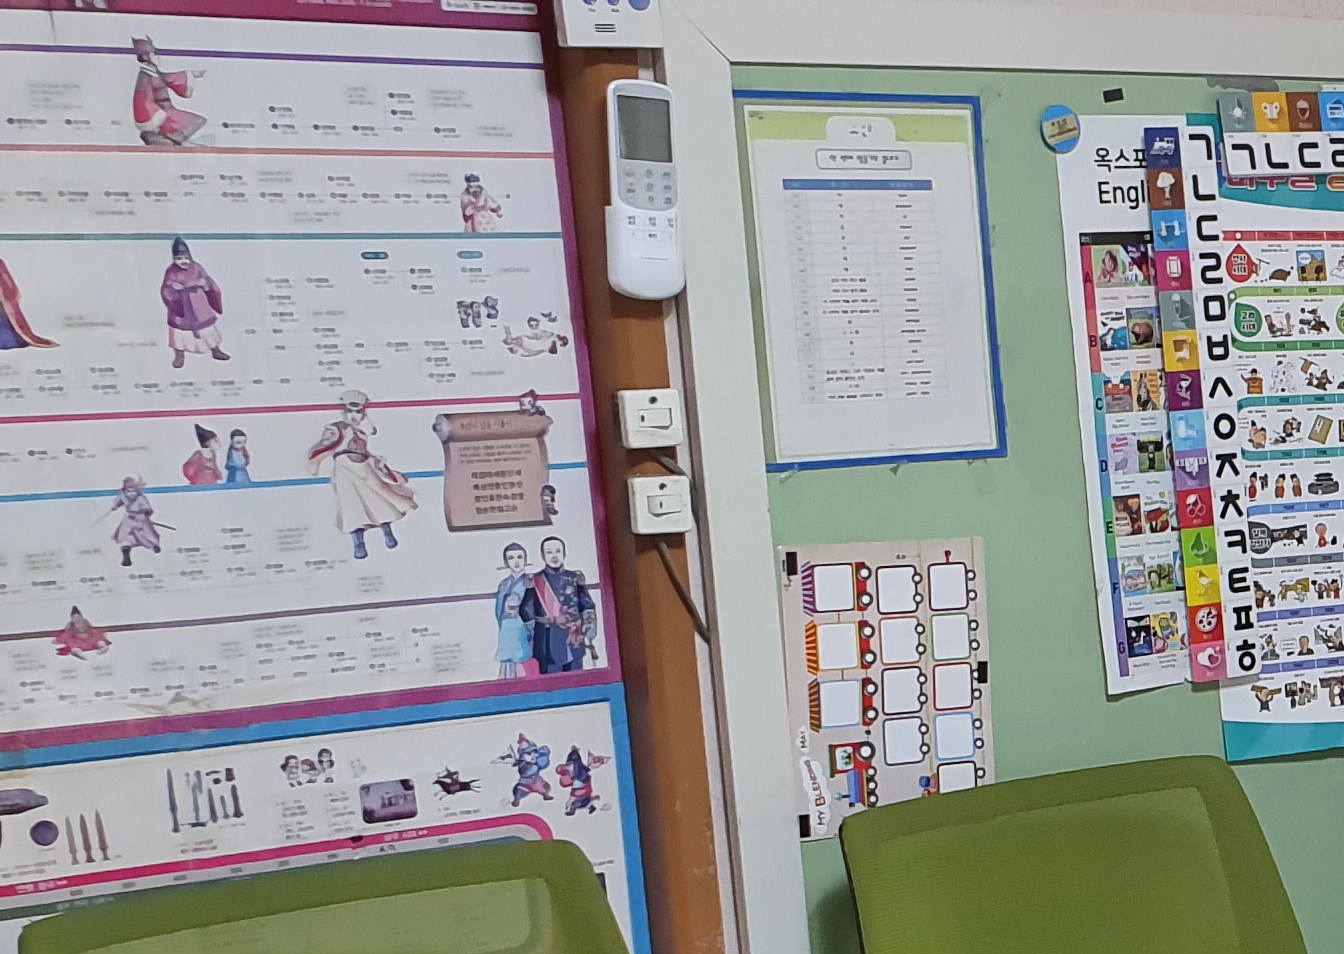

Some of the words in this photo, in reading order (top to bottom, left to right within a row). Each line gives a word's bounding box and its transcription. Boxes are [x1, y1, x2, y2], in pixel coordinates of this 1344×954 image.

[1188, 133, 1213, 161] ㄱ
[1191, 174, 1217, 202] ㄴ
[1196, 214, 1220, 242] ㄷ
[1198, 252, 1224, 285] ㄹ
[1203, 294, 1227, 322] ㅁ
[1206, 334, 1230, 362] ㅂ
[1208, 376, 1233, 399] ㅅ
[1213, 413, 1236, 441] ㅇ
[1215, 452, 1240, 479] ㅈ
[1219, 489, 1244, 520] ㅊ
[1223, 529, 1248, 555] ㅋ
[1227, 566, 1251, 594] ㅌ
[1232, 604, 1255, 631] ㅍ
[1235, 639, 1257, 672] ㅎ
